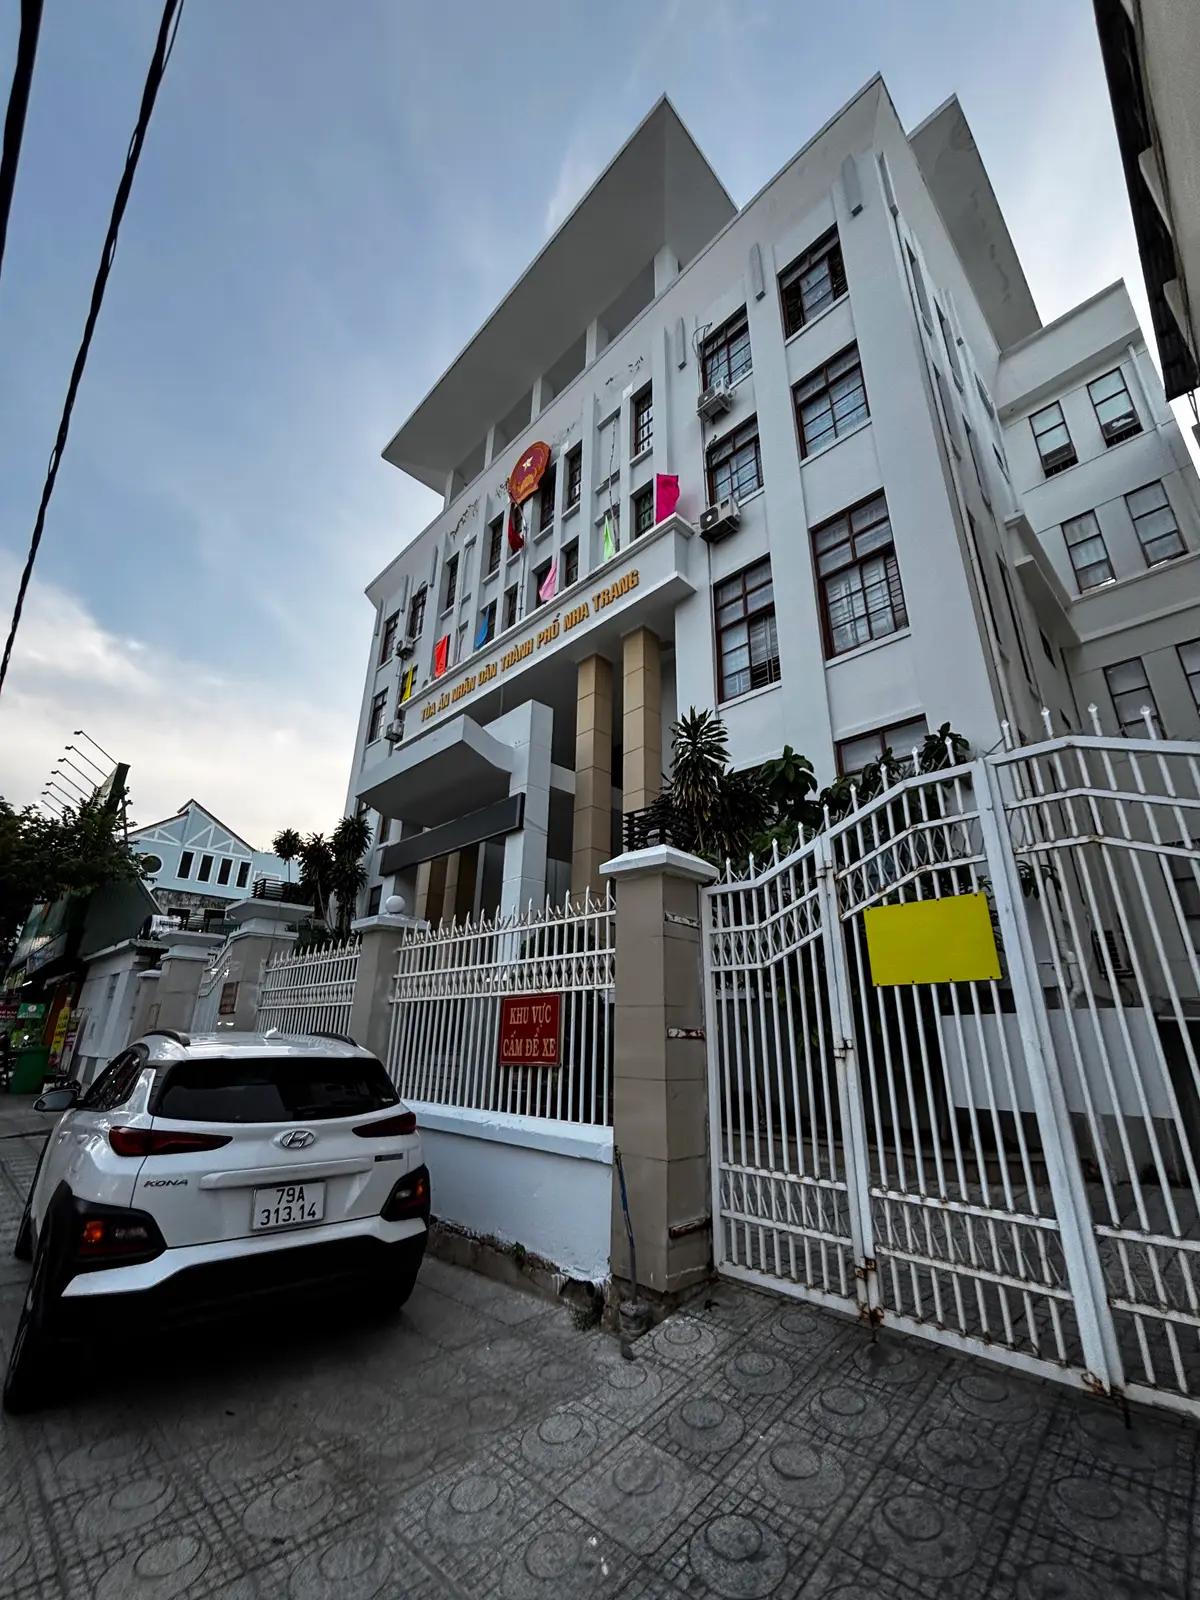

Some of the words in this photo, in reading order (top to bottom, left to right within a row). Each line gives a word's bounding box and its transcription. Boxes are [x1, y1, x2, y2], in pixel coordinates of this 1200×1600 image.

[437, 693, 450, 712] ÁN
[451, 676, 476, 703] NHÂN
[478, 662, 498, 686] DÂN
[500, 638, 534, 672] THÀNH
[536, 612, 560, 649] PHỐ
[563, 602, 590, 632] NHA
[592, 569, 640, 612] TRANG
[510, 1007, 529, 1025] KHU
[532, 1002, 551, 1028] VỰC
[503, 1031, 523, 1056] CẤM
[525, 1027, 539, 1056] ĐỂ
[542, 1038, 556, 1057] XE
[143, 1178, 188, 1188] KONA
[276, 1186, 304, 1205] 79A
[260, 1202, 317, 1226] 313.14
